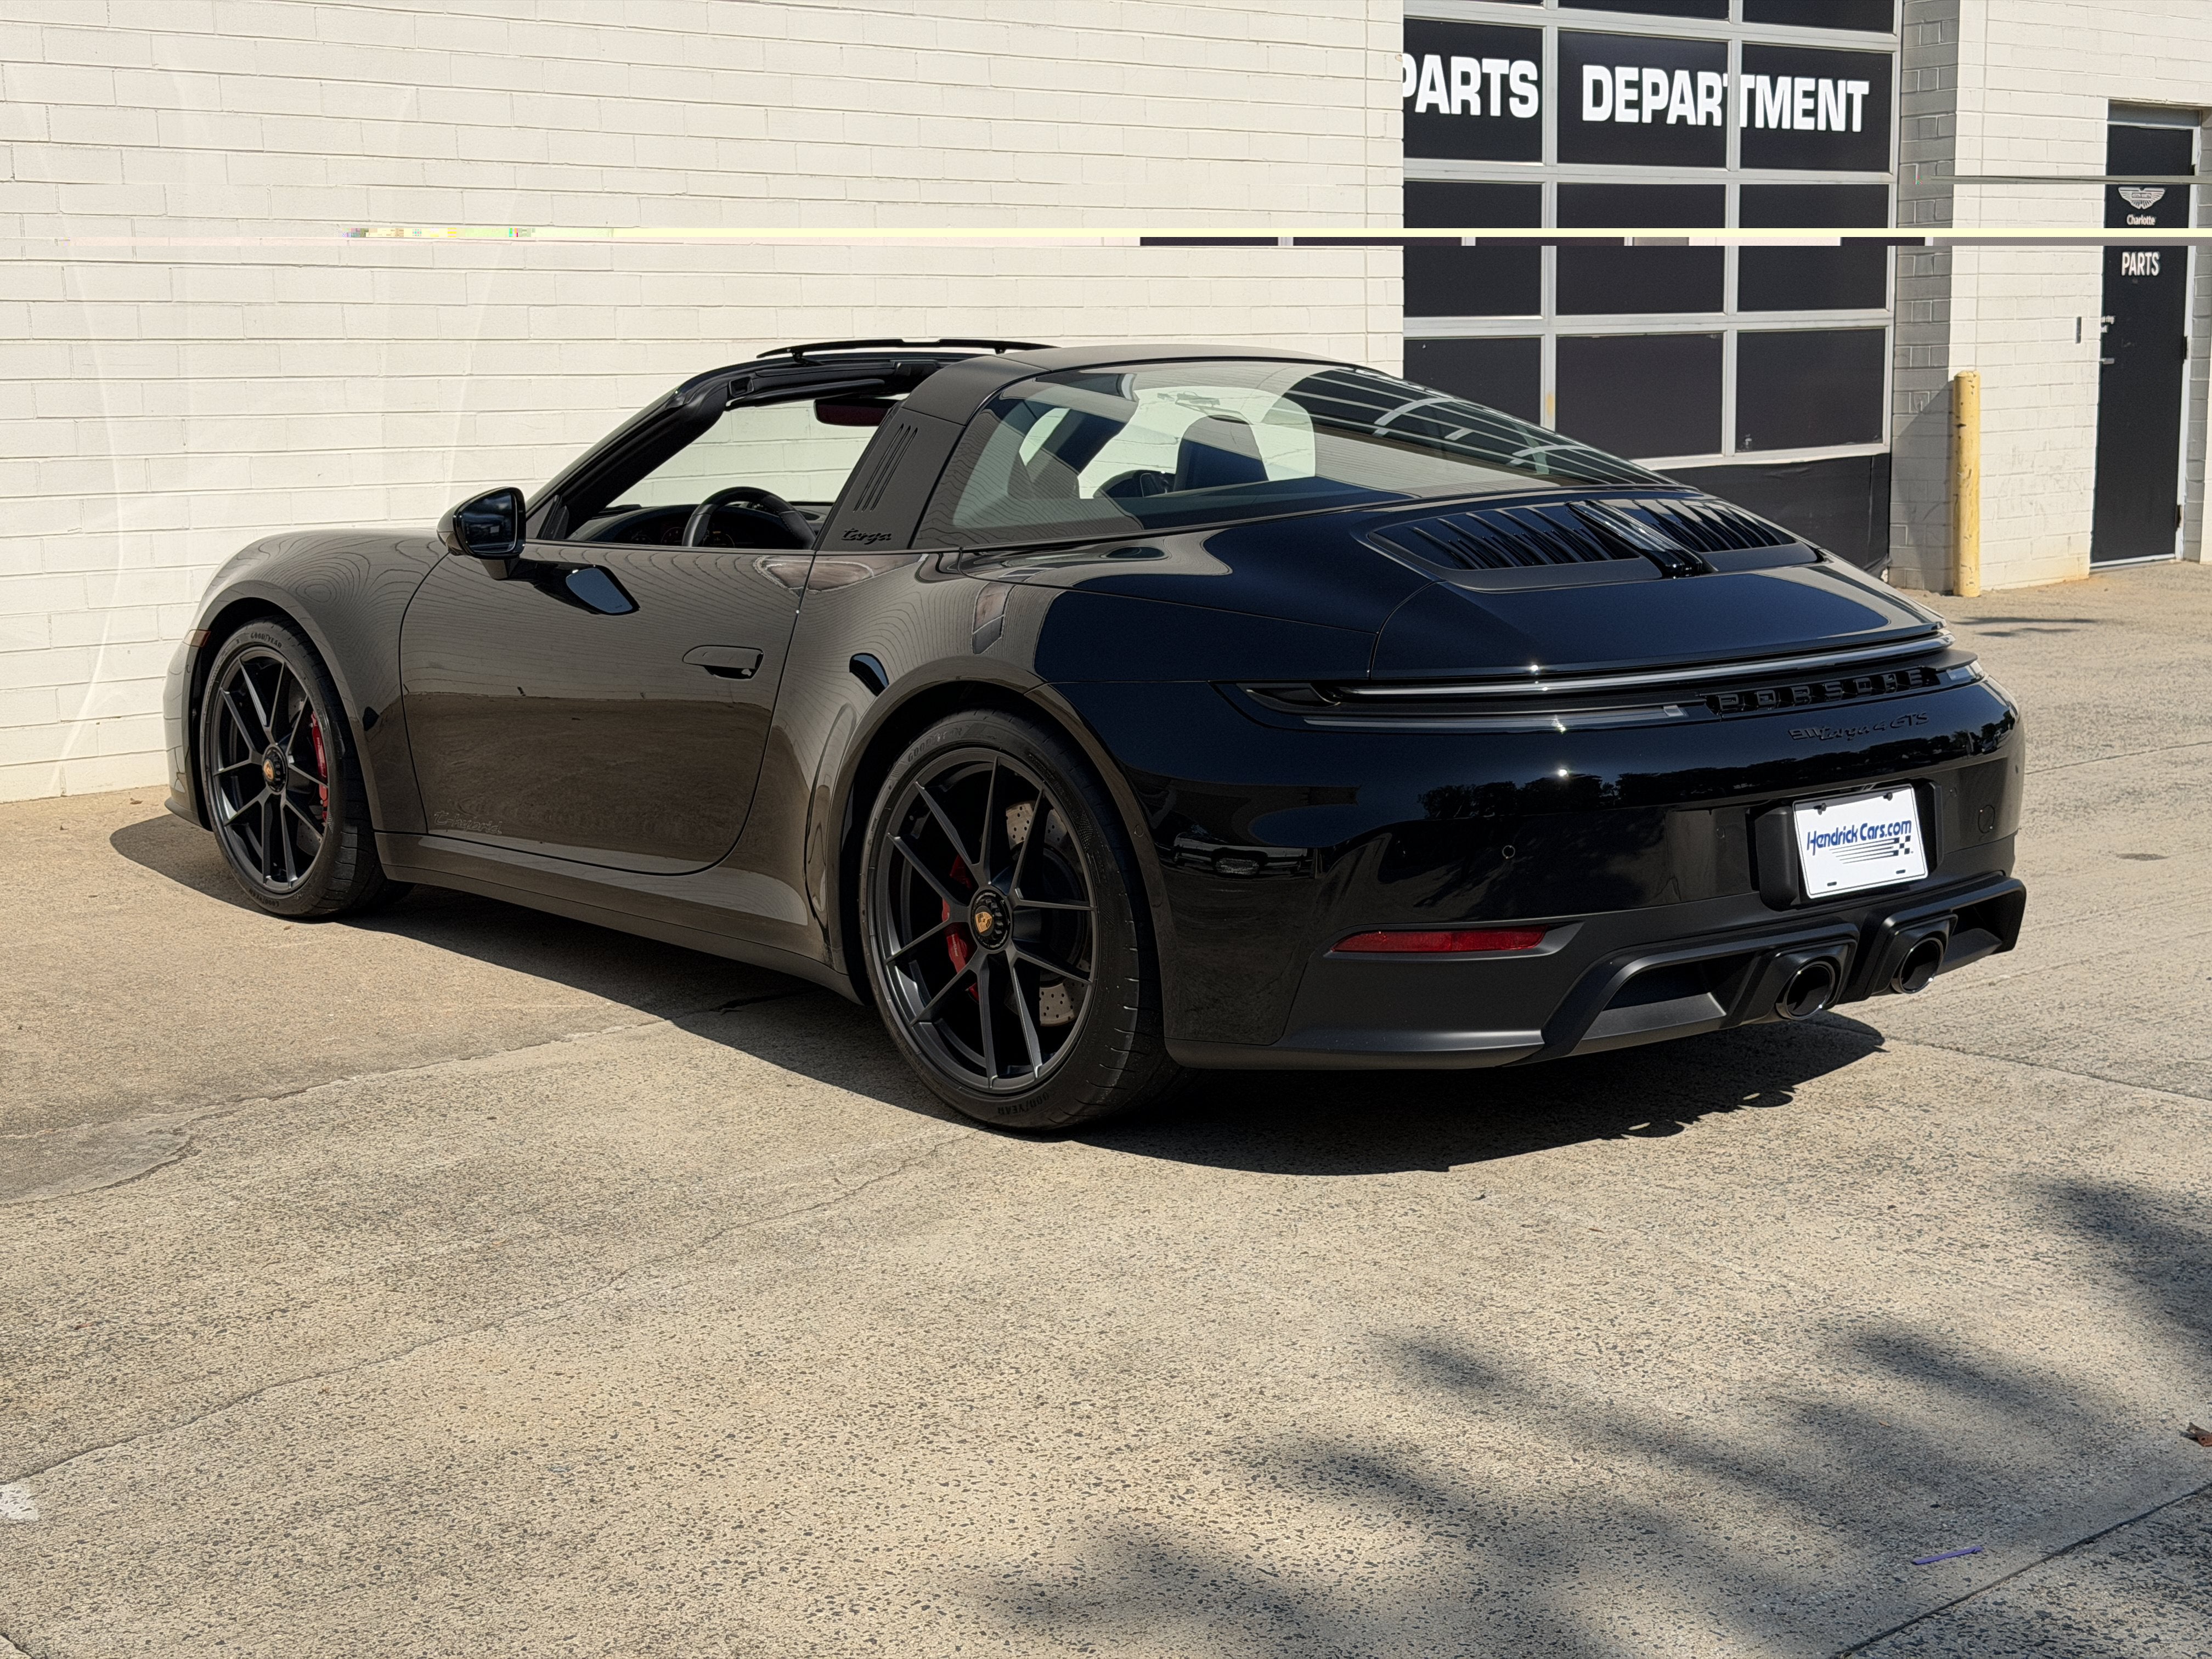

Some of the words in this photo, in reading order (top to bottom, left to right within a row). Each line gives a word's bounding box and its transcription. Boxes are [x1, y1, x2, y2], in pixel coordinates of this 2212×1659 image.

[1582, 64, 1870, 132] DEPARTMENT
[2126, 214, 2156, 225] Charlotte
[2121, 251, 2160, 276] PARTS
[841, 528, 891, 545] Targa
[1717, 669, 1923, 711] PORSCHE
[1889, 712, 1929, 729] GTS
